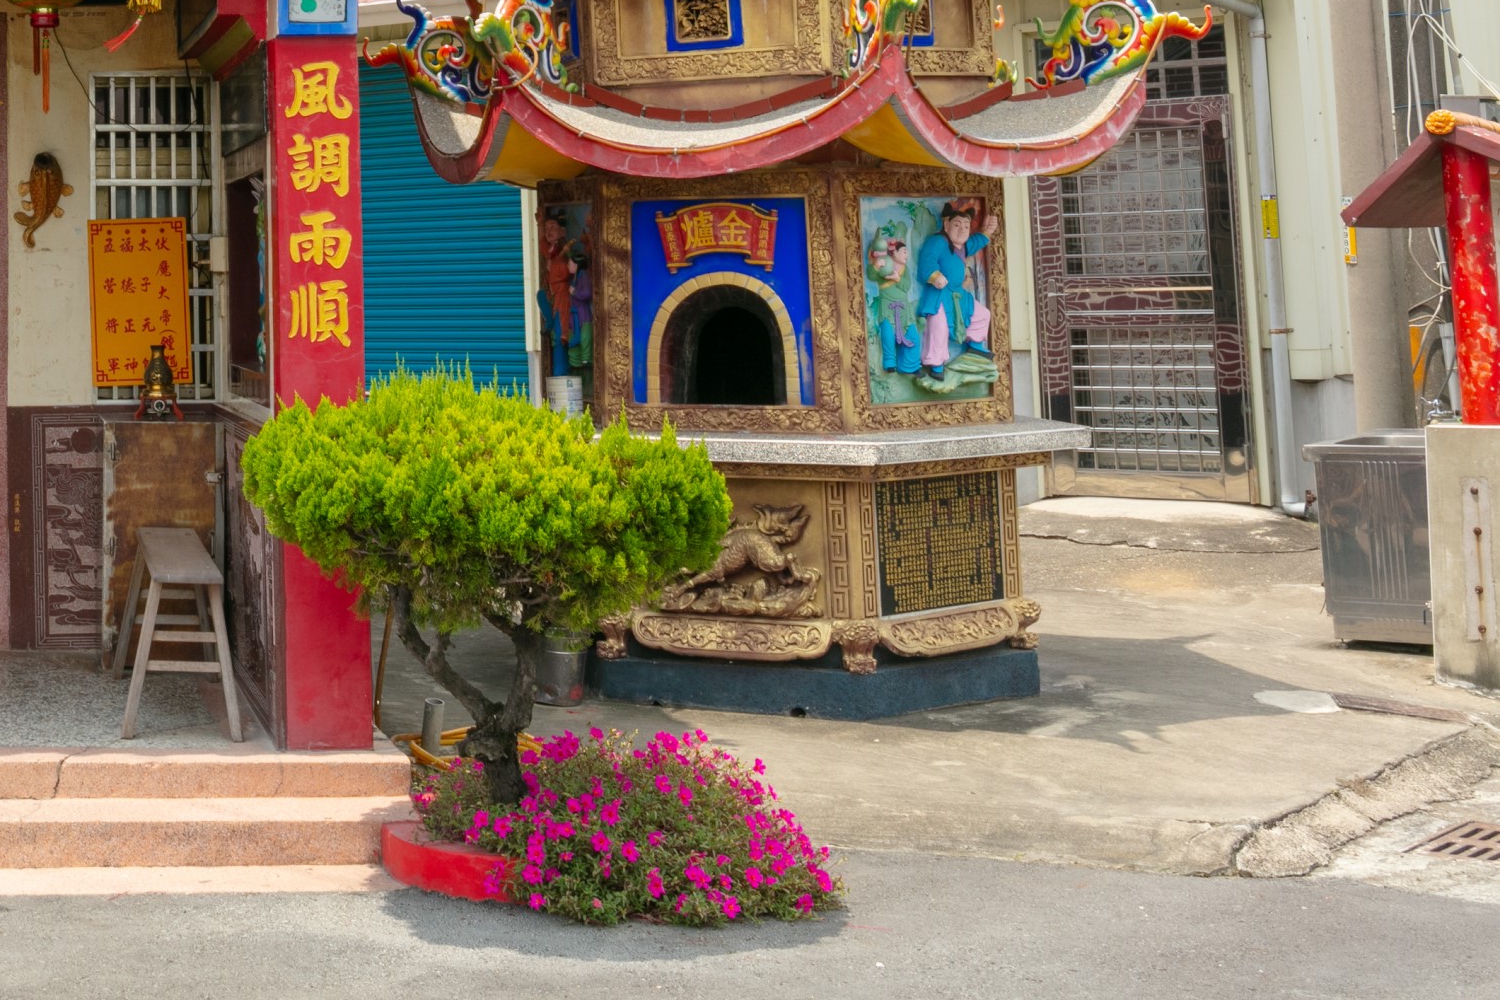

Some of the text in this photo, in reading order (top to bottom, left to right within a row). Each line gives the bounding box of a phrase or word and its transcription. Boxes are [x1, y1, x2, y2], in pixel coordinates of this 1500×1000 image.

[284, 60, 354, 348] 風調雨順
[680, 209, 752, 251] 金爐
[119, 237, 138, 374] 福德正神
